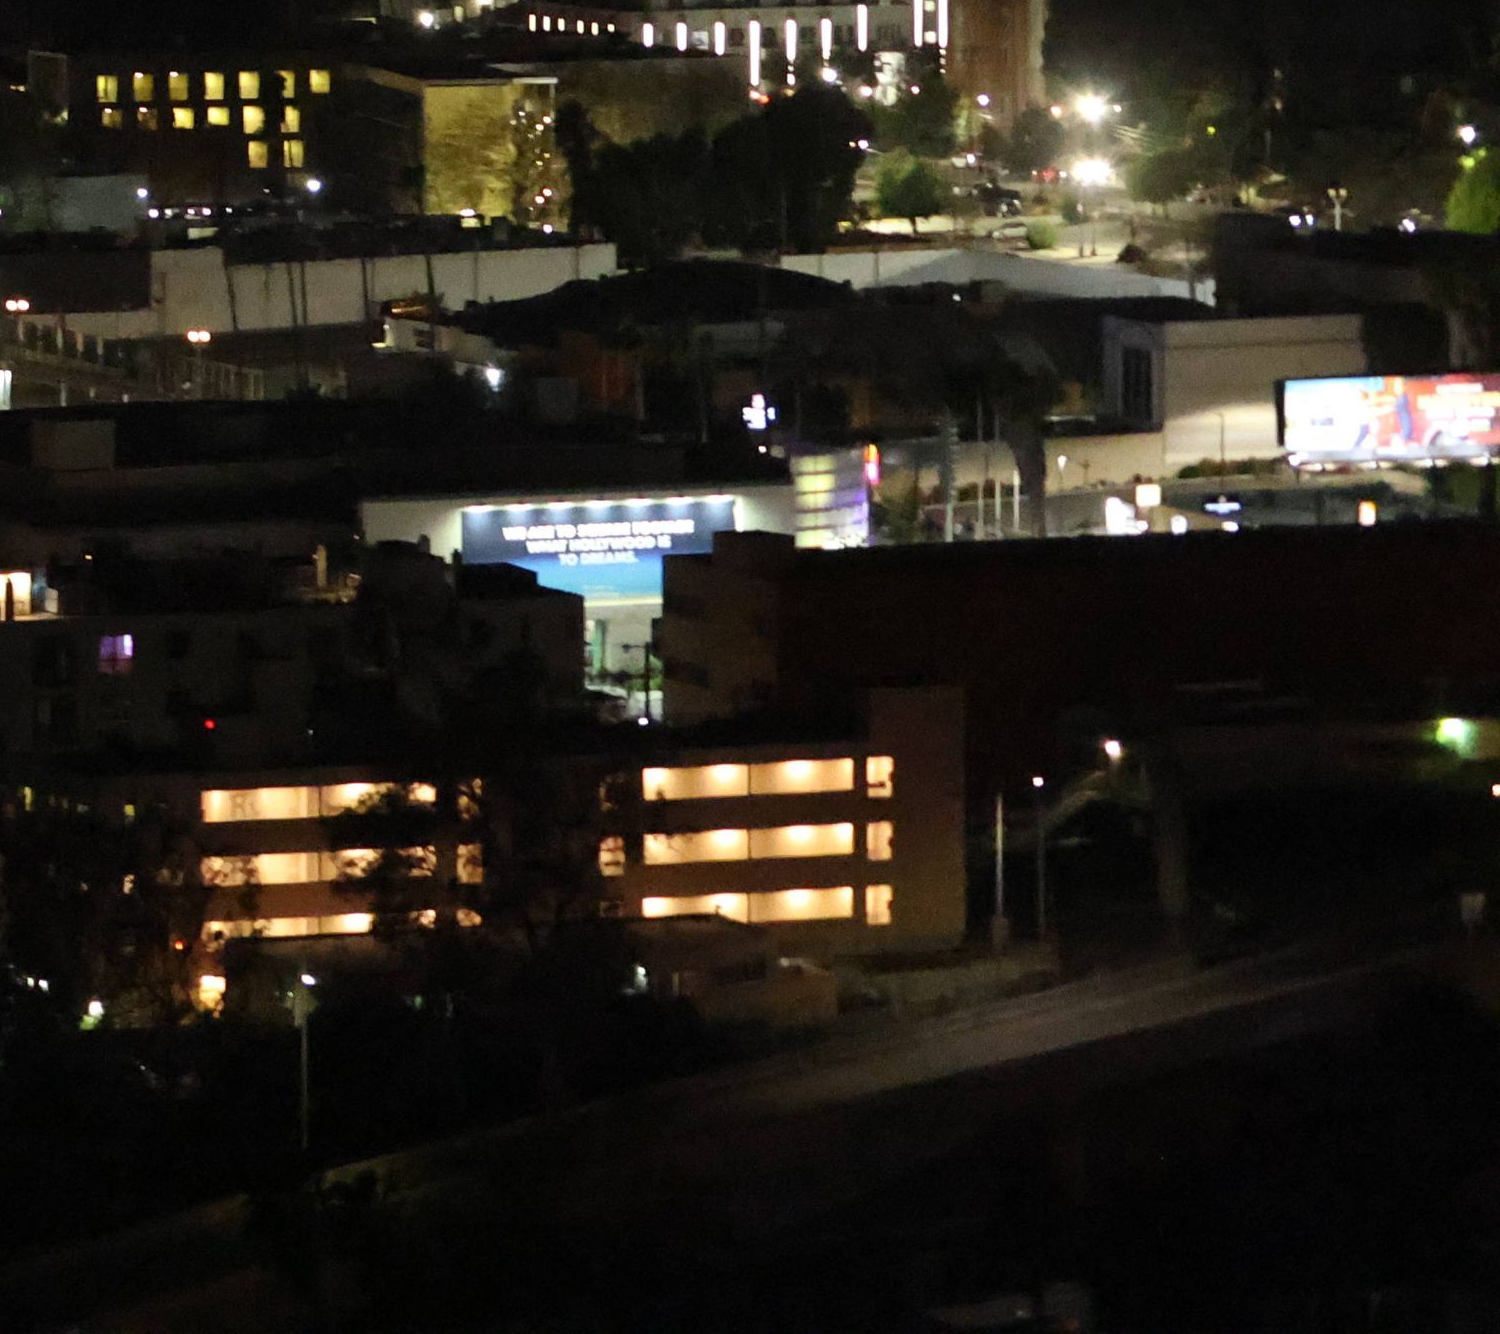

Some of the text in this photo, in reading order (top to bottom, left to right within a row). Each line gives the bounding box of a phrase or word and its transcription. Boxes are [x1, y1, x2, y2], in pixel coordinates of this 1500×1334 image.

[526, 539, 568, 553] WHAT
[568, 534, 656, 552] HOLLYWOOD
[558, 552, 579, 566] TO
